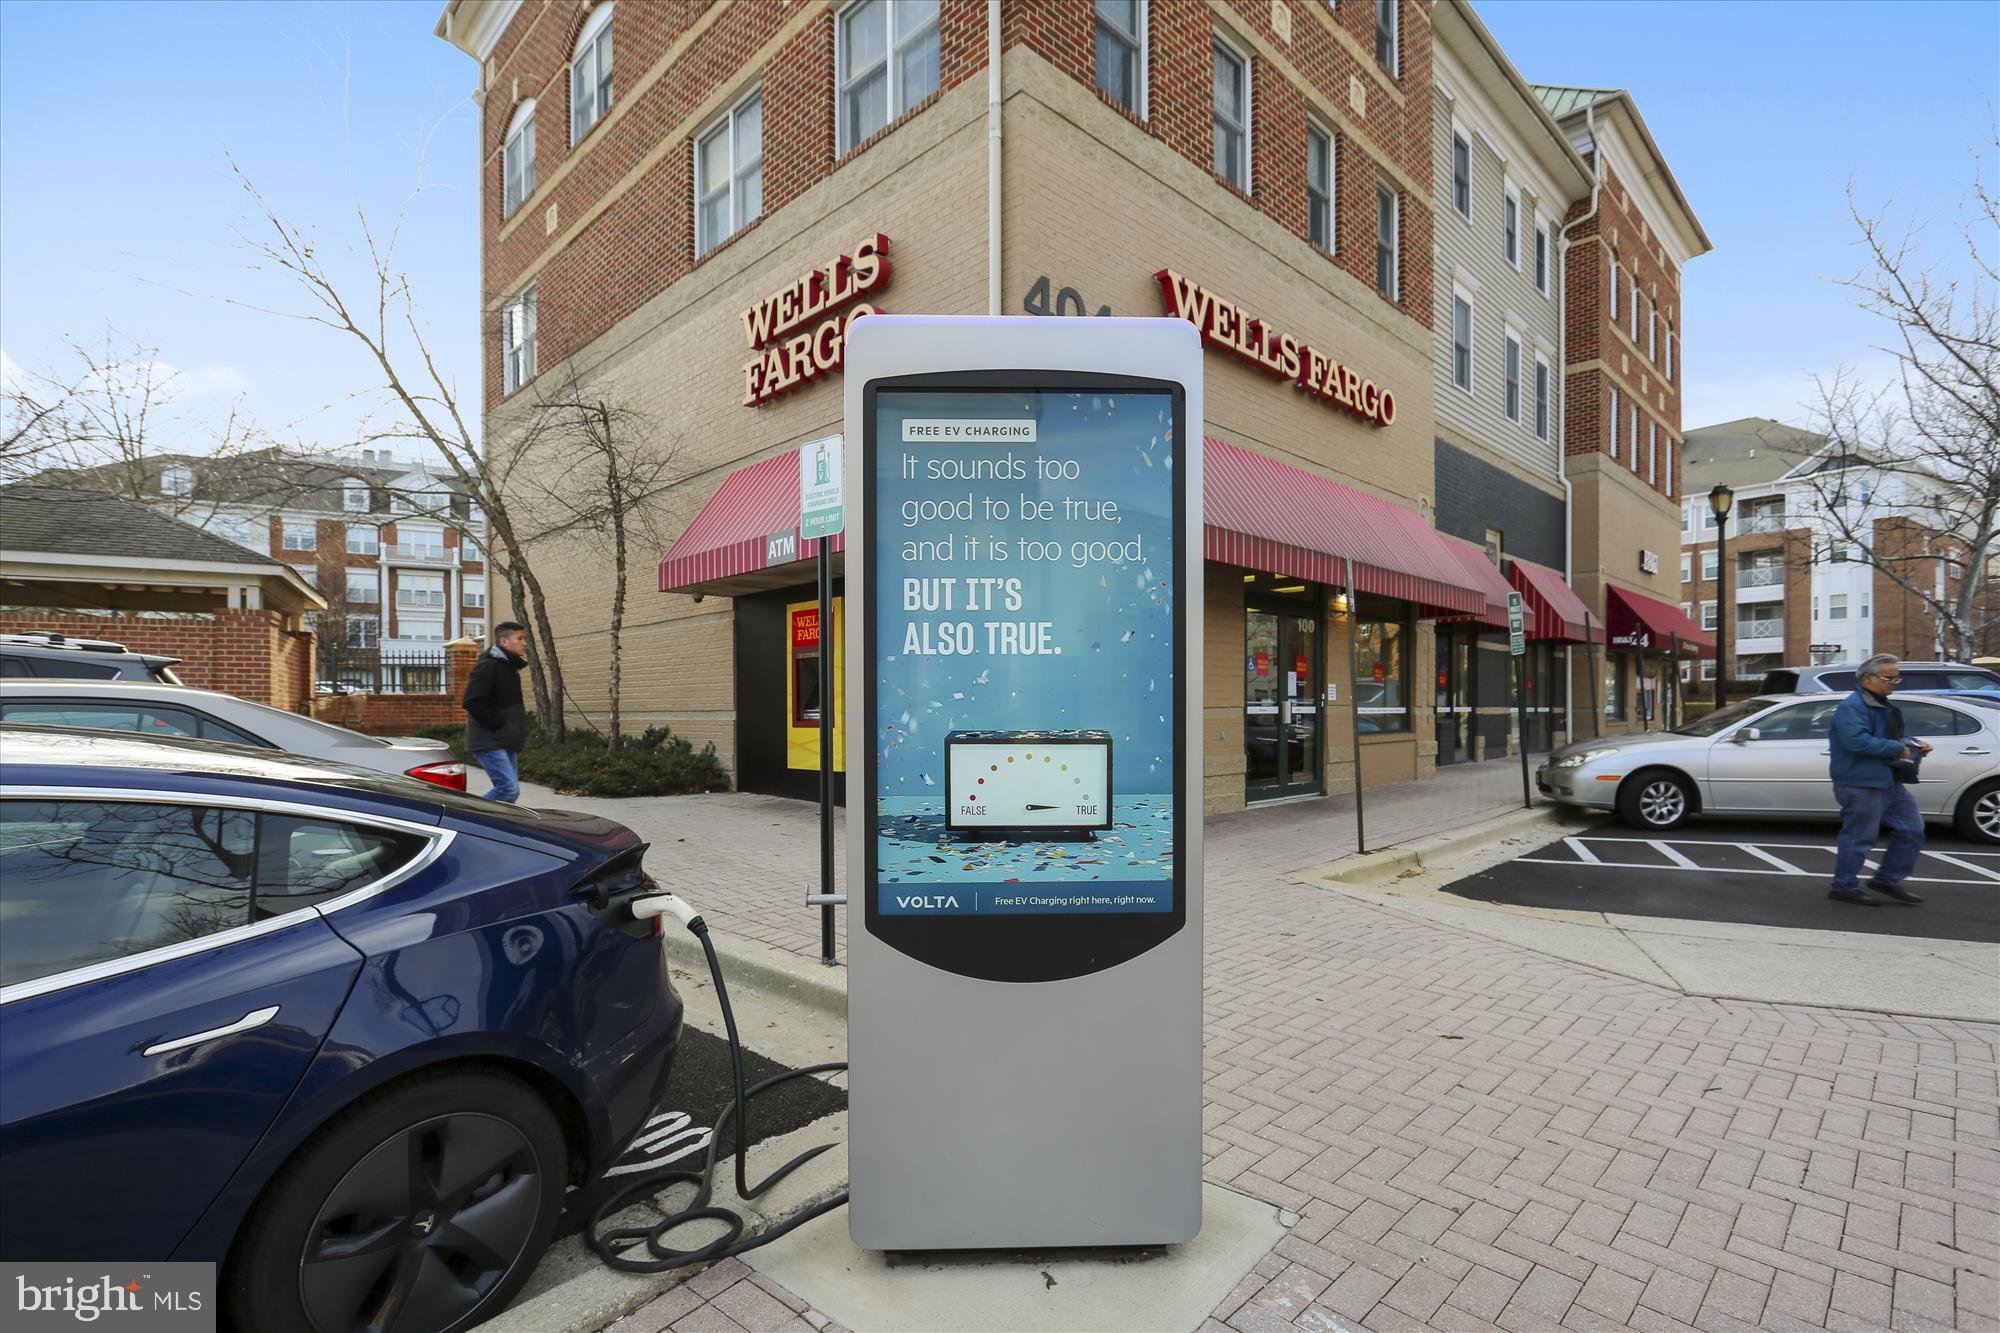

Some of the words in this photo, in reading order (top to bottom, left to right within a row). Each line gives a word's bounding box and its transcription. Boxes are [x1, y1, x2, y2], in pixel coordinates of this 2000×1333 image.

[739, 233, 889, 350] WELLS
[1024, 275, 1111, 316] 40
[1157, 268, 1300, 381] WELLS
[1300, 345, 1397, 427] FARGO
[908, 426, 940, 436] FREE
[944, 426, 961, 436] EV
[965, 426, 1031, 437] CHARGING
[902, 453, 919, 480] It
[927, 452, 1026, 480] sounds
[1035, 455, 1080, 480] too
[805, 518, 810, 527] 2
[810, 516, 825, 526] HOUR
[825, 512, 840, 523] LIMIT
[901, 493, 973, 527] good
[982, 496, 1010, 521] to
[1020, 493, 1054, 521] be
[1062, 496, 1122, 525] true,
[768, 535, 794, 559] ATM
[901, 534, 953, 561] and
[964, 534, 980, 561] it
[989, 534, 1009, 561] is
[1017, 537, 1062, 561] too
[1071, 533, 1148, 568] good,
[903, 577, 957, 611] BUT
[797, 614, 820, 628] WEL
[1297, 618, 1315, 633] 100
[797, 628, 820, 640] FARG
[902, 622, 974, 656] ALSO
[983, 622, 1062, 656] TRUE.
[961, 805, 987, 816] FALSE
[1076, 805, 1098, 816] TRUE
[896, 895, 960, 909] VOLTA
[995, 896, 1014, 906] Free
[1016, 896, 1028, 905] EV
[1029, 895, 1068, 907] Charging
[1069, 895, 1090, 907] right
[1091, 895, 1112, 906] here,
[1113, 895, 1134, 907] right
[1136, 896, 1156, 904] now.
